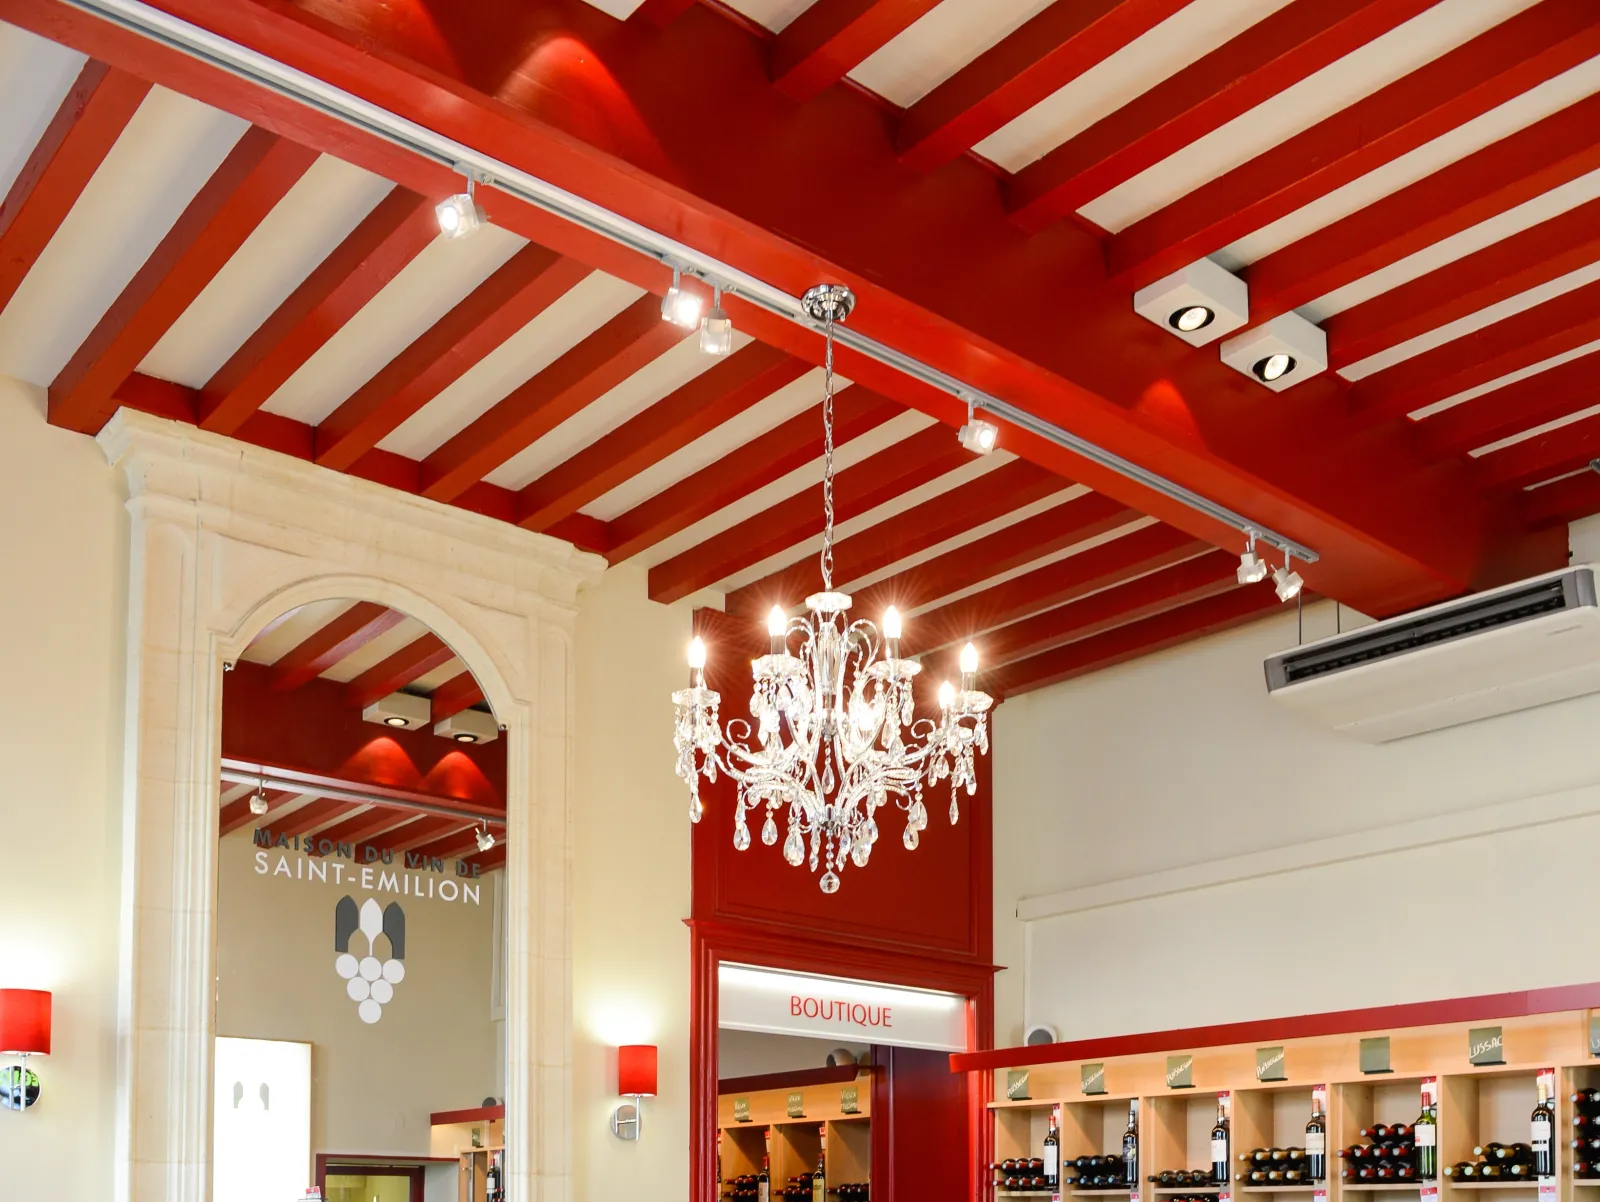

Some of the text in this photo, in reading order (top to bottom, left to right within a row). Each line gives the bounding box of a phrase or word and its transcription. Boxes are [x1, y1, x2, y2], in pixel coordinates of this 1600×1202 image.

[253, 828, 481, 879] MAISON DU VIN DE
[254, 851, 480, 906] SAINT-EMILION
[790, 995, 892, 1027] BOUTIQUE
[1469, 1035, 1503, 1059] LUSSAC
